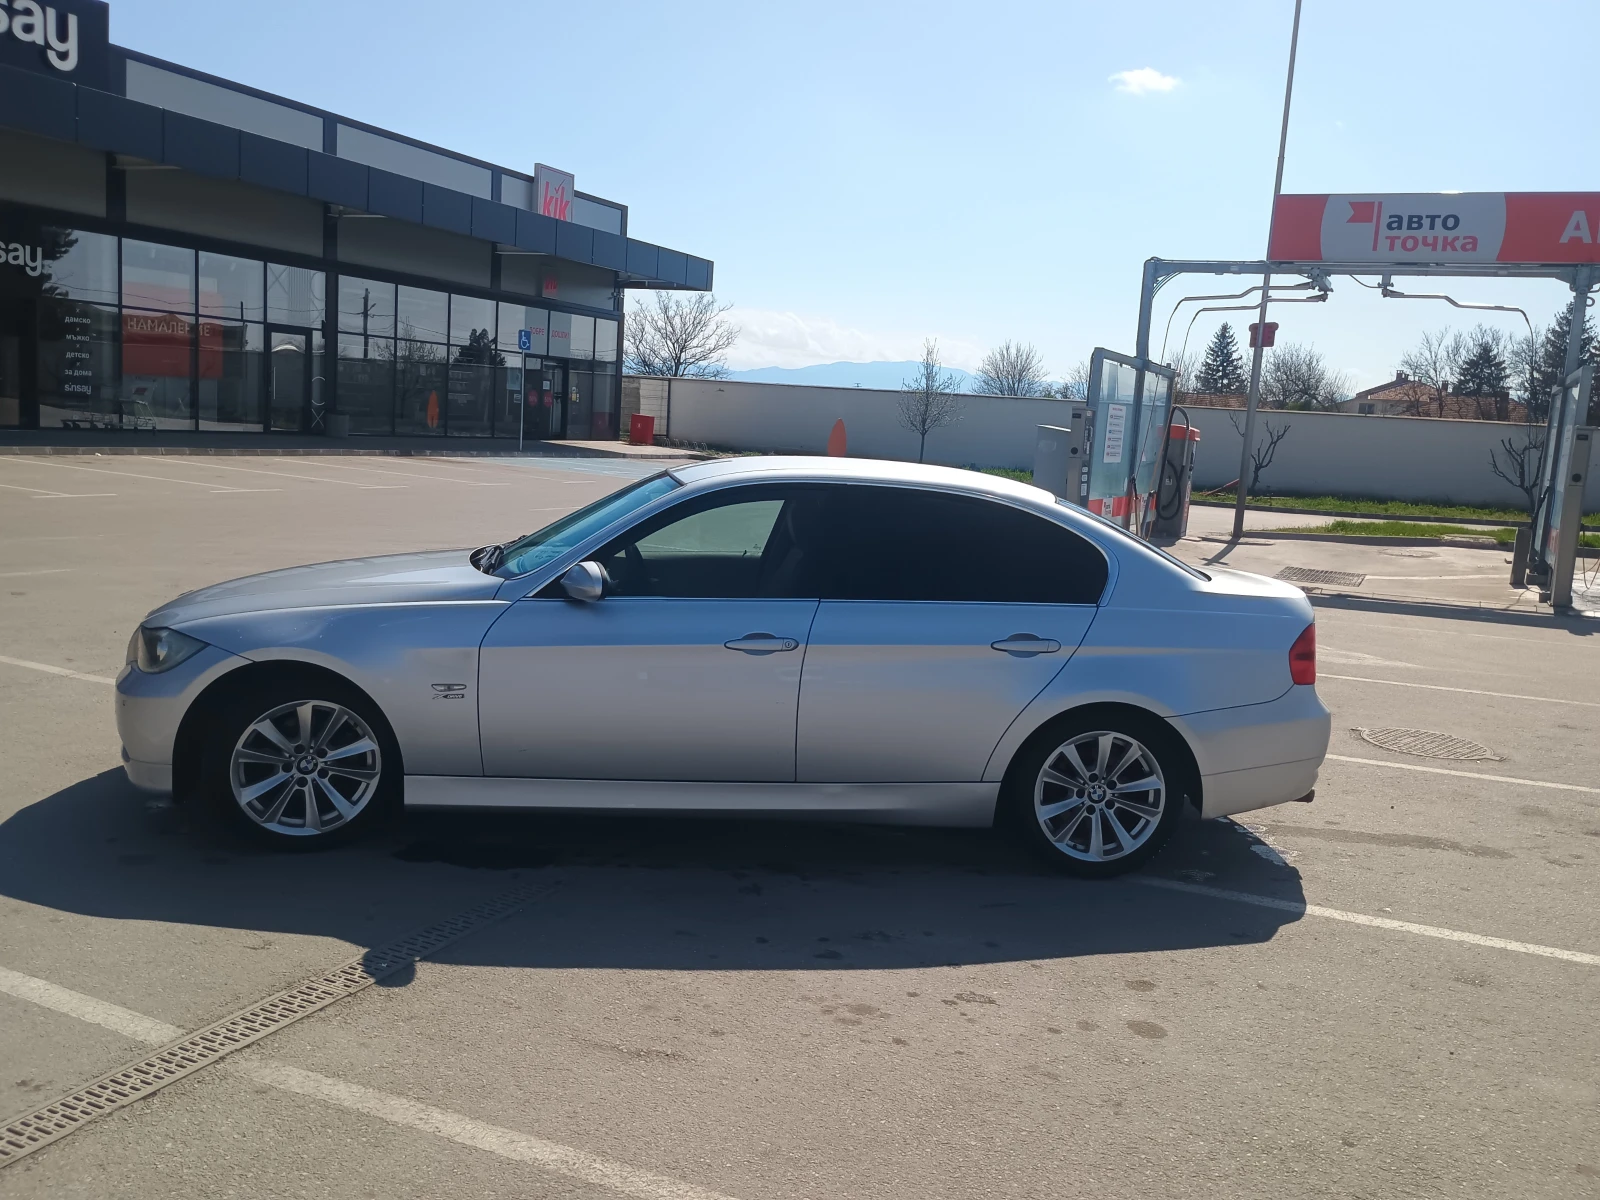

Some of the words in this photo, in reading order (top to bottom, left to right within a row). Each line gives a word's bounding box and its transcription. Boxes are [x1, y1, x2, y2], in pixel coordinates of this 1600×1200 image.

[1386, 213, 1461, 231] авто
[1384, 235, 1479, 252] точка
[64, 316, 91, 324] дамско
[65, 334, 90, 342] мъжко
[65, 351, 90, 359] детско
[73, 369, 92, 377] дома
[64, 382, 92, 395] sinsay
